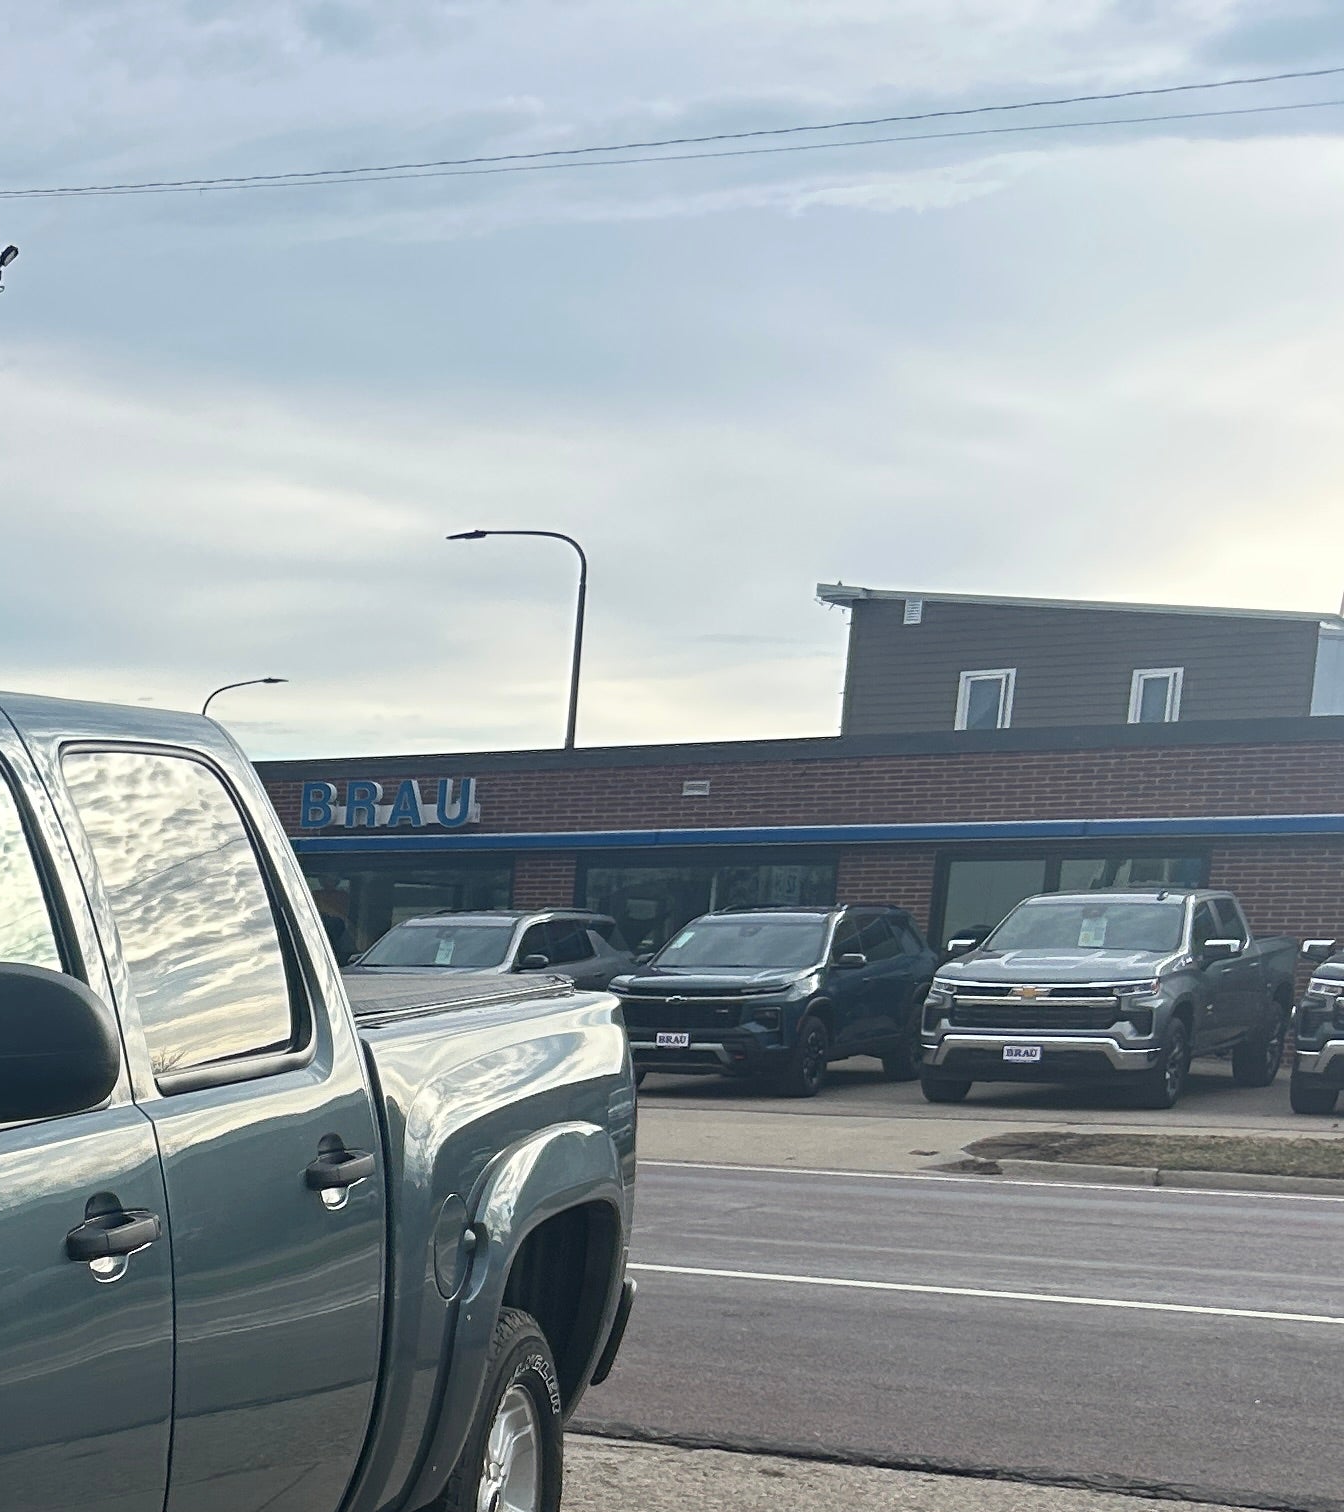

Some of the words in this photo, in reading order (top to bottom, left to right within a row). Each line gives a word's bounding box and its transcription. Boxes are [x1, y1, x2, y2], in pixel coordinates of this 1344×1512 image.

[299, 776, 477, 829] BRAU
[658, 1034, 687, 1044] BRAU
[1005, 1048, 1038, 1058] BRAU
